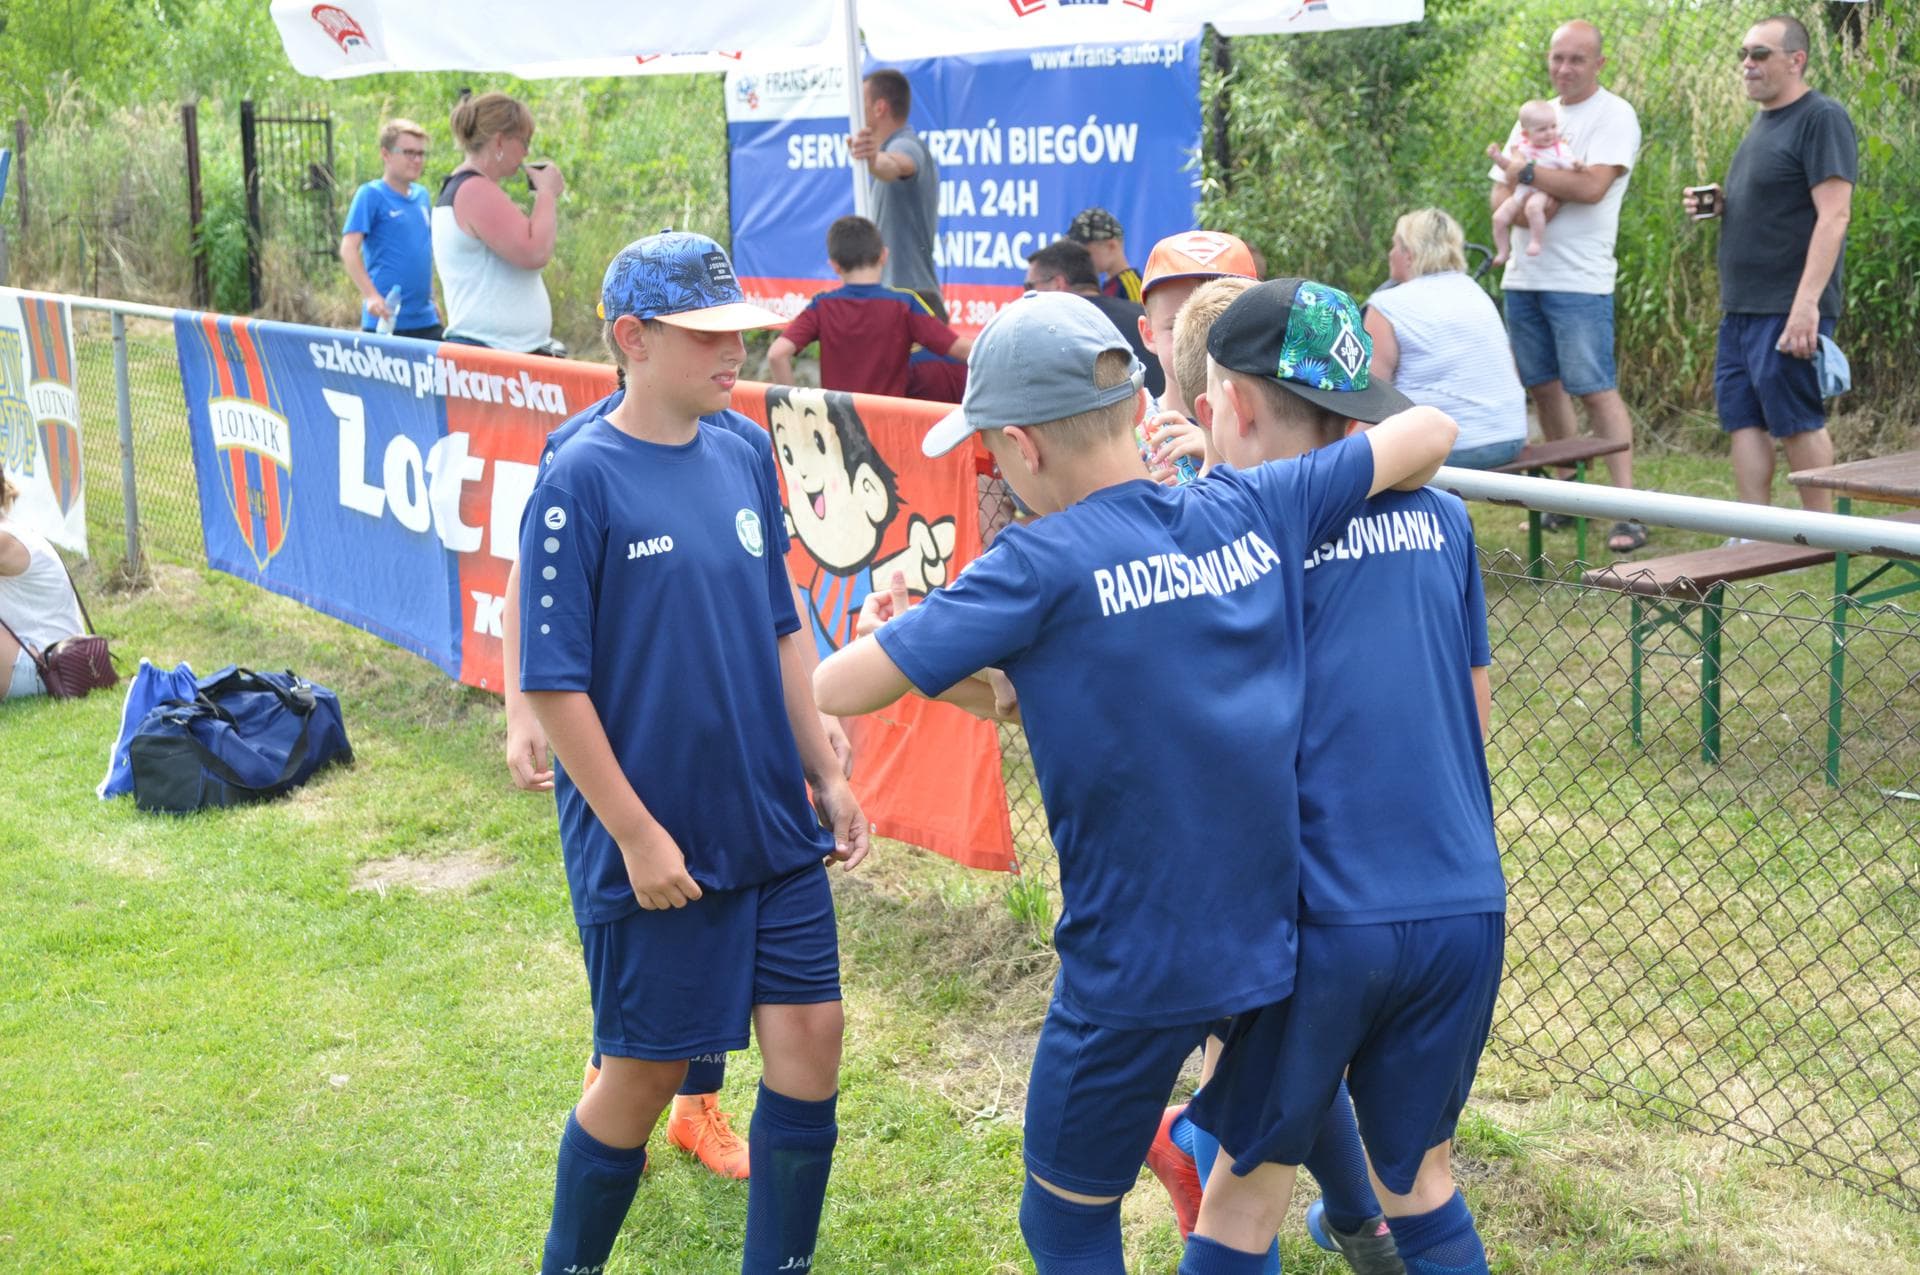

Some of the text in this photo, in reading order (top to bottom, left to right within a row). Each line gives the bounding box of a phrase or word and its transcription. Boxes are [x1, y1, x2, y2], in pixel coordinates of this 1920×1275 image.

[1008, 114, 1138, 165] BIEGÓW
[980, 178, 1039, 217] 24H
[310, 337, 411, 387] szkółka
[412, 354, 567, 415] piłkarska
[627, 535, 674, 560] JAKO
